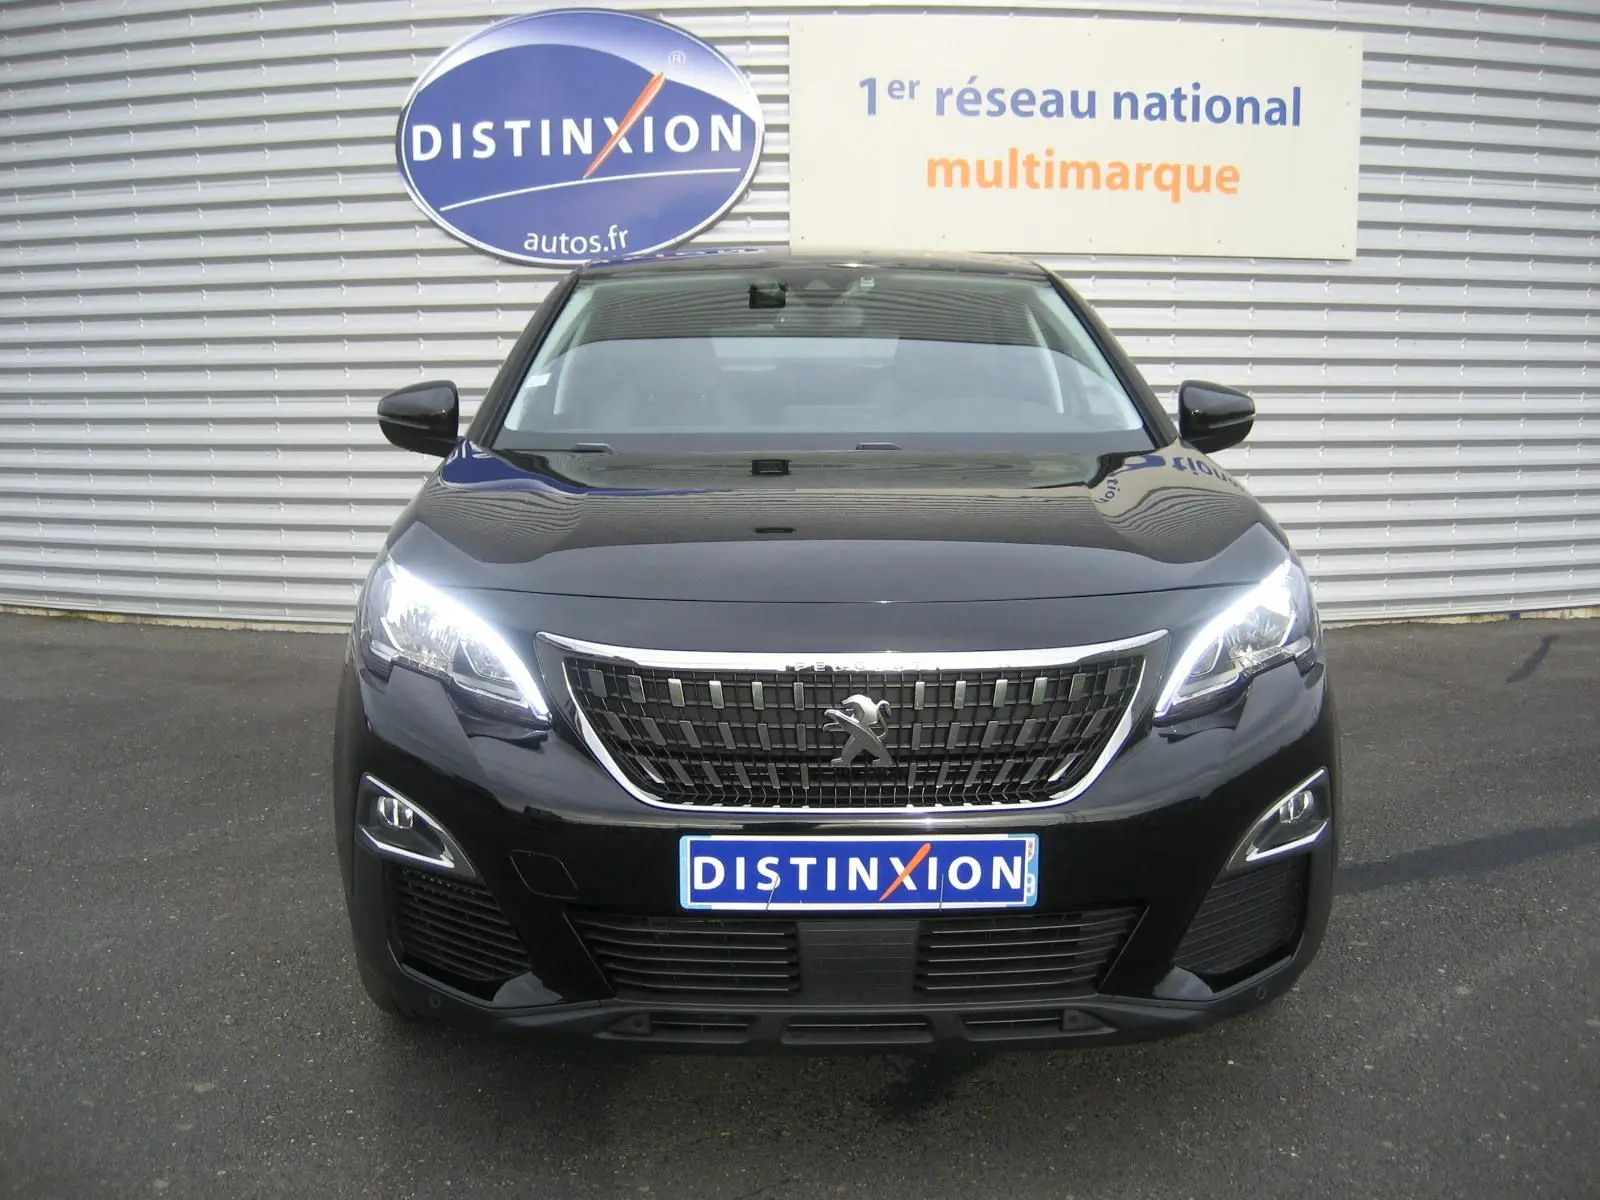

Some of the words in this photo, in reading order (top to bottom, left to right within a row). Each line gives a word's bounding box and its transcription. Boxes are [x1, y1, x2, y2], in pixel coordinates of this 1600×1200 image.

[859, 76, 921, 116] 1er
[935, 76, 1097, 119] réseau
[1113, 82, 1301, 126] national
[927, 148, 1240, 203] multimarque
[524, 225, 628, 254] autos.fr
